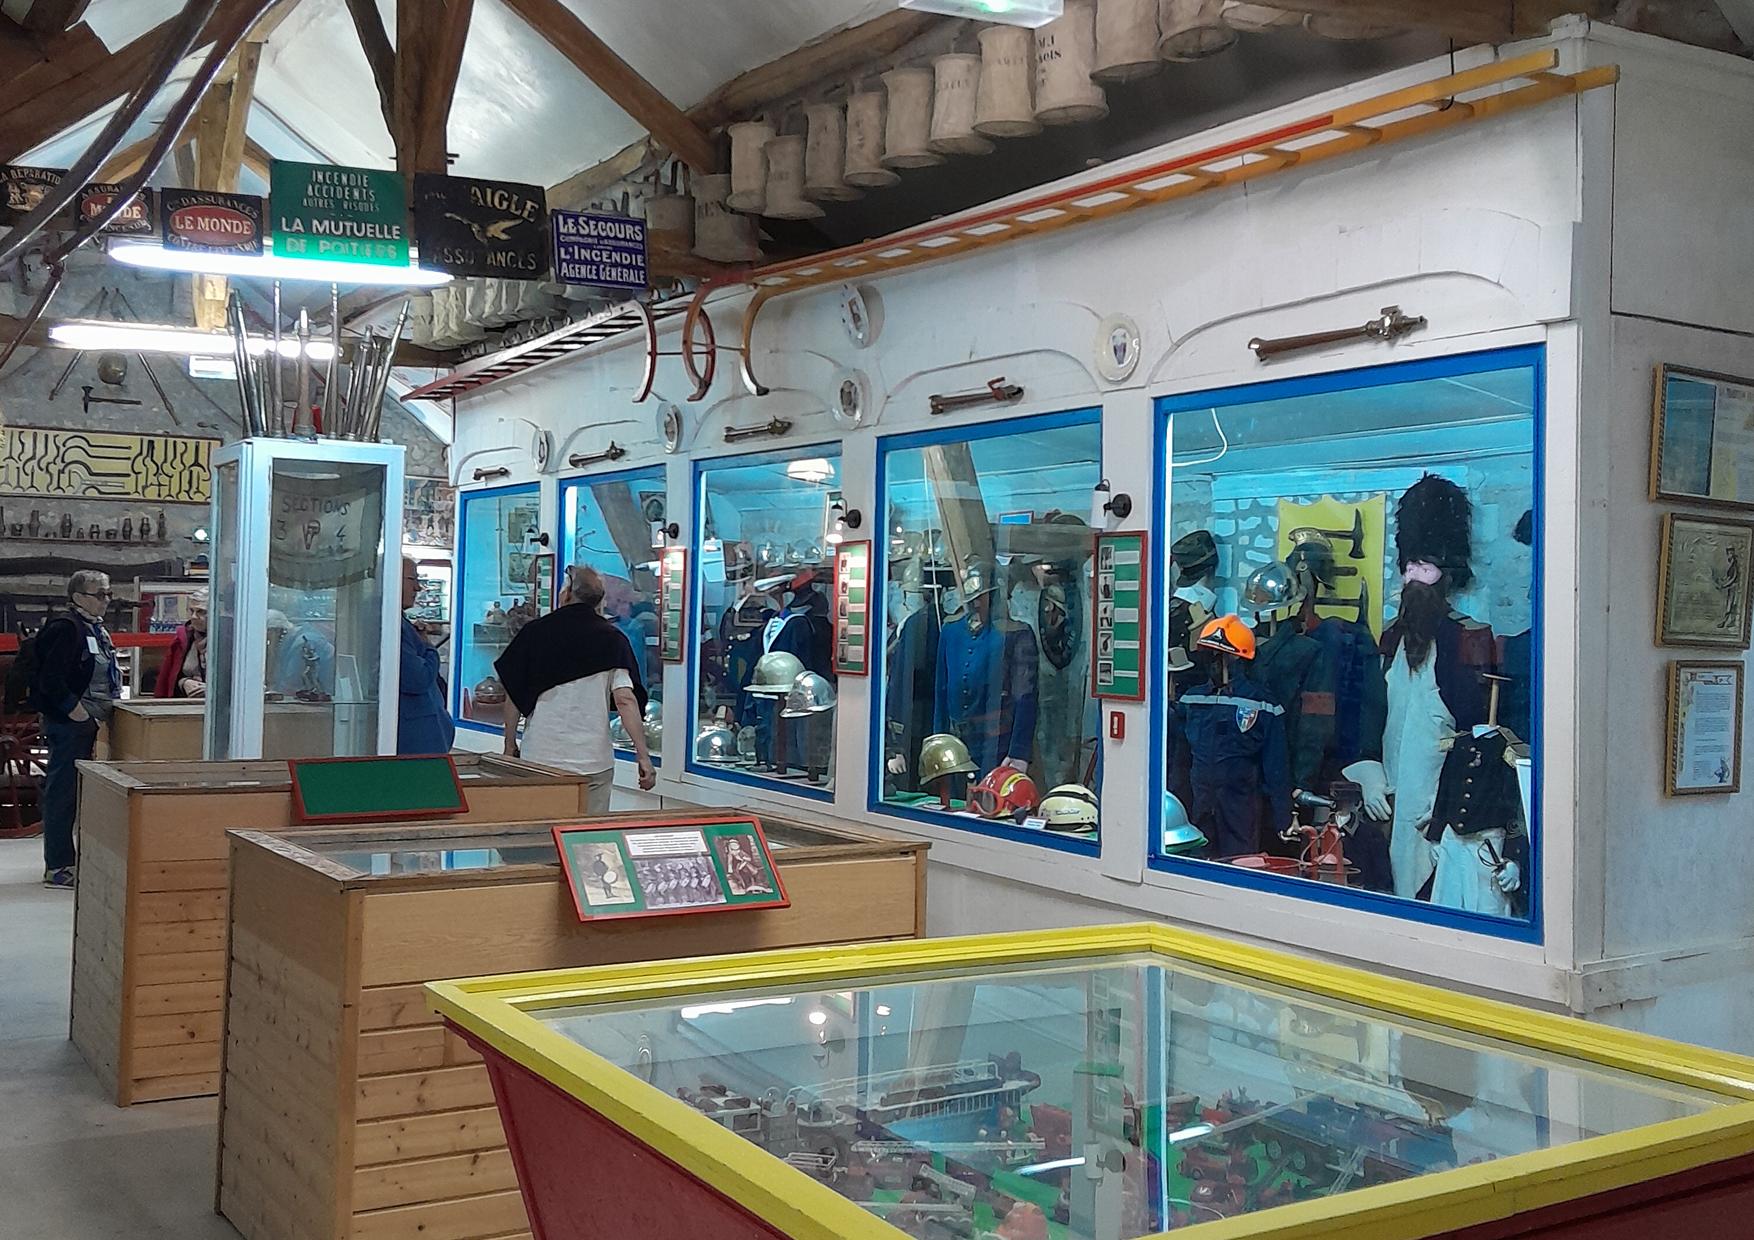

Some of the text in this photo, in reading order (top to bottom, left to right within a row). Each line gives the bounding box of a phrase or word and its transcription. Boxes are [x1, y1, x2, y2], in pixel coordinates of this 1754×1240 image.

[311, 169, 370, 188] INCENDIE
[306, 183, 376, 202] ACCIDENTS
[302, 197, 380, 213] AUTRES RISQUES
[469, 184, 541, 224] AIGLE
[174, 215, 252, 235] LE MONDE
[281, 216, 401, 240] LA MUTUELLE
[557, 213, 644, 242] LE SECOURS
[285, 236, 308, 254] DE
[559, 245, 645, 267] L'INCENDIE
[560, 261, 598, 281] AGENCE
[282, 496, 352, 515] SECTIONS
